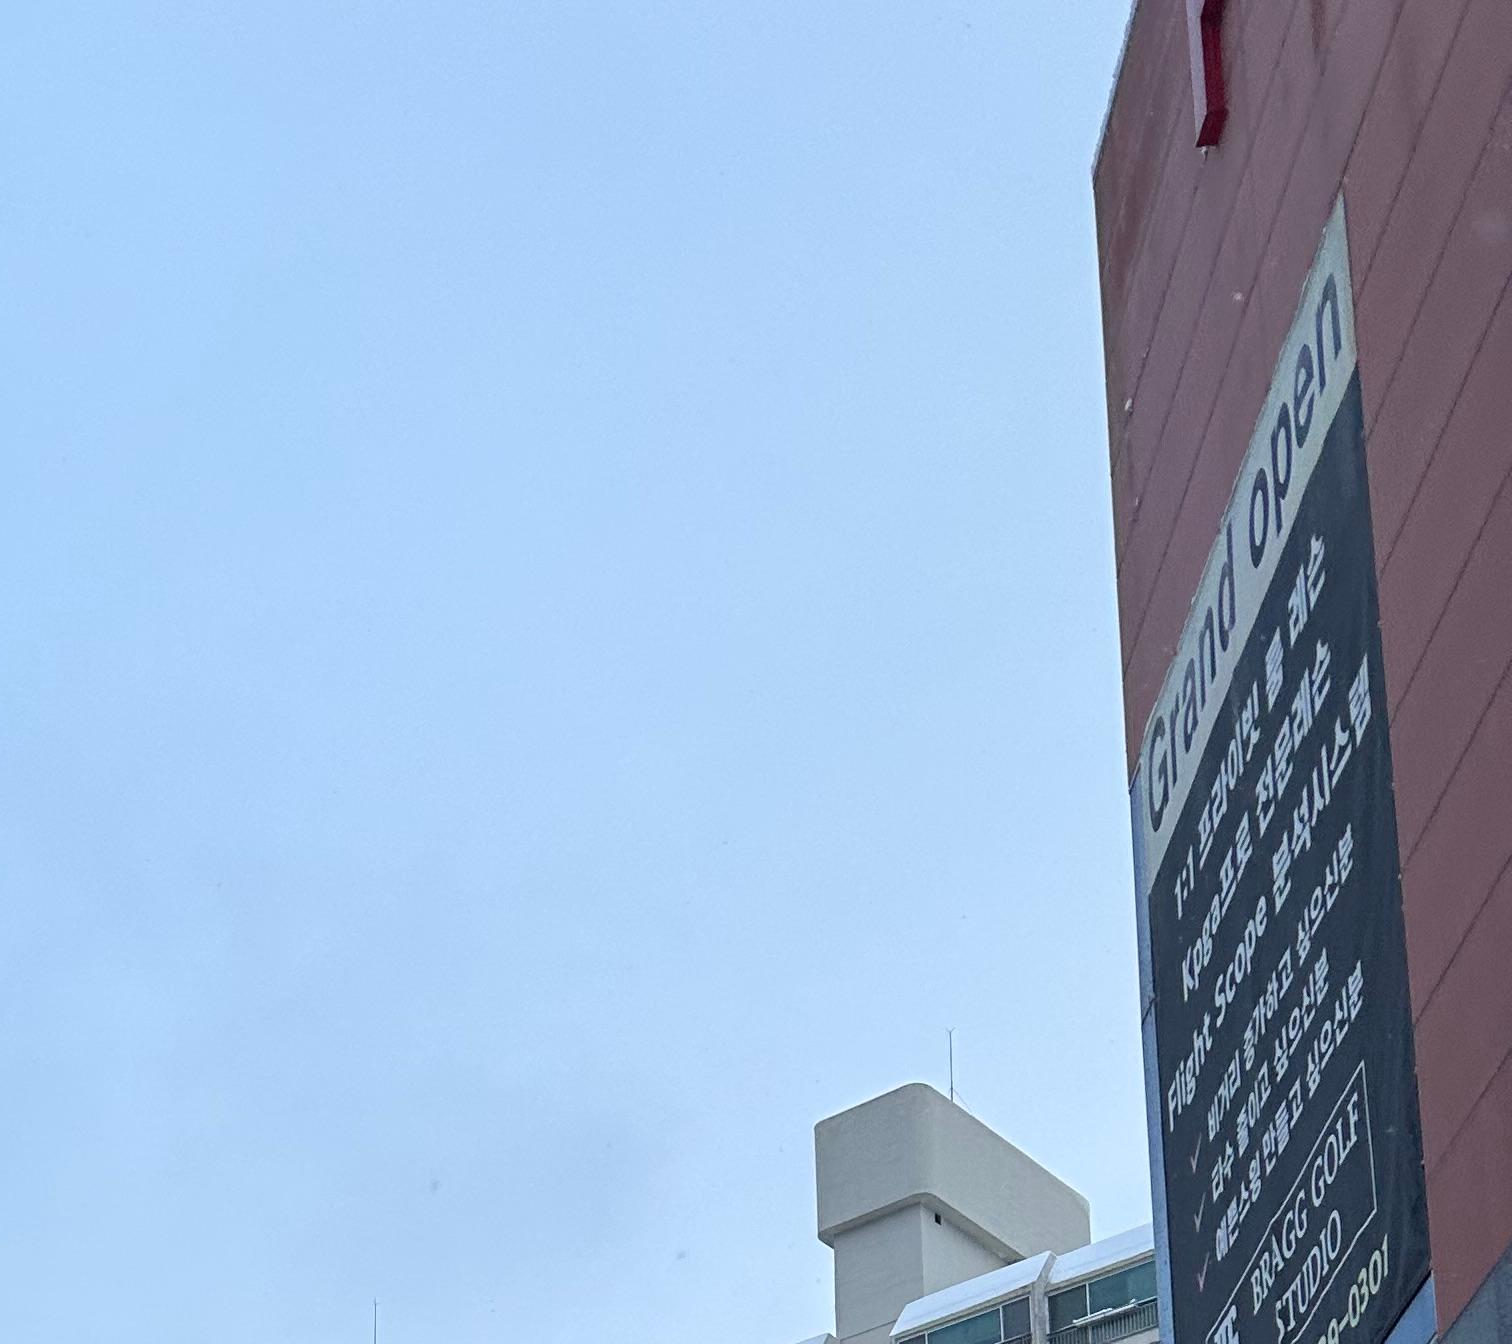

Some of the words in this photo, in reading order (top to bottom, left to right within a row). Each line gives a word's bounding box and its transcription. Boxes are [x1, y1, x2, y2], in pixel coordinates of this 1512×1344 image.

[1148, 518, 1235, 832] Grand
[1248, 273, 1341, 569] open
[1167, 1011, 1212, 1132] Flight
[1214, 895, 1267, 1027] Scope
[1272, 653, 1371, 914] 분석시스템
[1174, 845, 1194, 919] 1:1
[1197, 680, 1260, 869] 프라이빗
[1265, 626, 1283, 712] 룸
[1287, 534, 1325, 648] 레슨
[1181, 811, 1252, 1002] Kpga프로
[1255, 639, 1330, 838] 전문레슨
[1207, 1049, 1240, 1142] 비거리
[1243, 946, 1293, 1070] 증가하고
[1295, 823, 1353, 966] 싶으신분
[1211, 1140, 1234, 1202] 타수
[1273, 947, 1328, 1082] 싶으신분
[1305, 959, 1363, 1098] 싶으신분
[1250, 1188, 1307, 1315] BRAGG
[1311, 1091, 1358, 1207] GOLF
